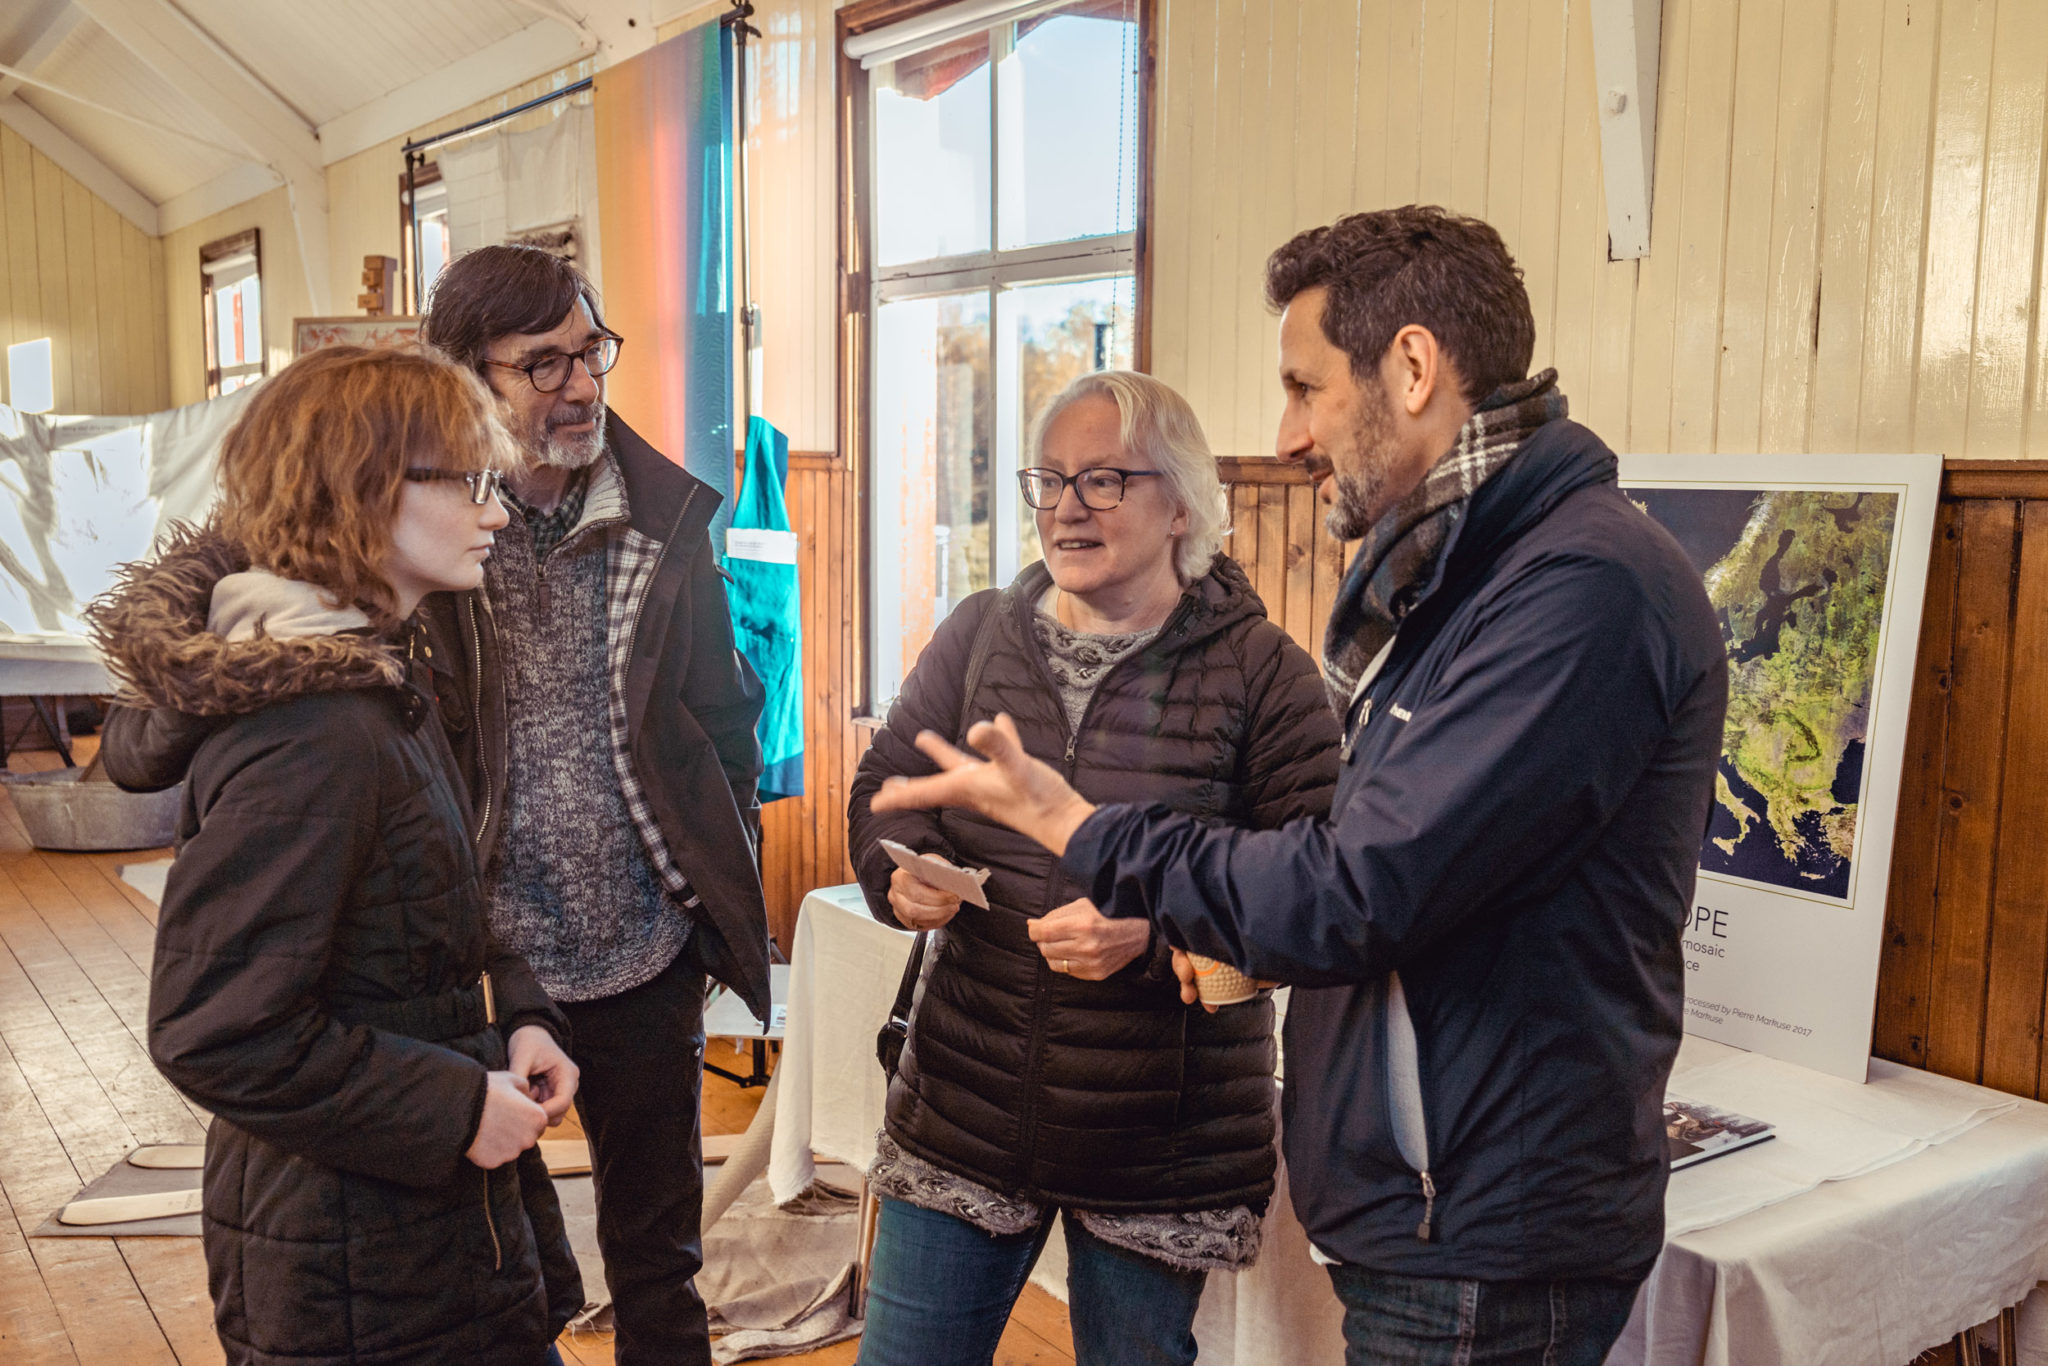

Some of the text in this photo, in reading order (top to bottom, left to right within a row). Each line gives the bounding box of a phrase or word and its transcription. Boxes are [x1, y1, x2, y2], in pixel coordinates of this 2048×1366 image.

[1682, 939, 1726, 958] mosaic
[1685, 960, 1700, 972] ce
[1685, 996, 1721, 1012] rocessed
[1721, 1005, 1732, 1016] by
[1732, 1007, 1755, 1022] Pierre
[1756, 1013, 1792, 1031] Markuse
[1792, 1025, 1813, 1037] 2017
